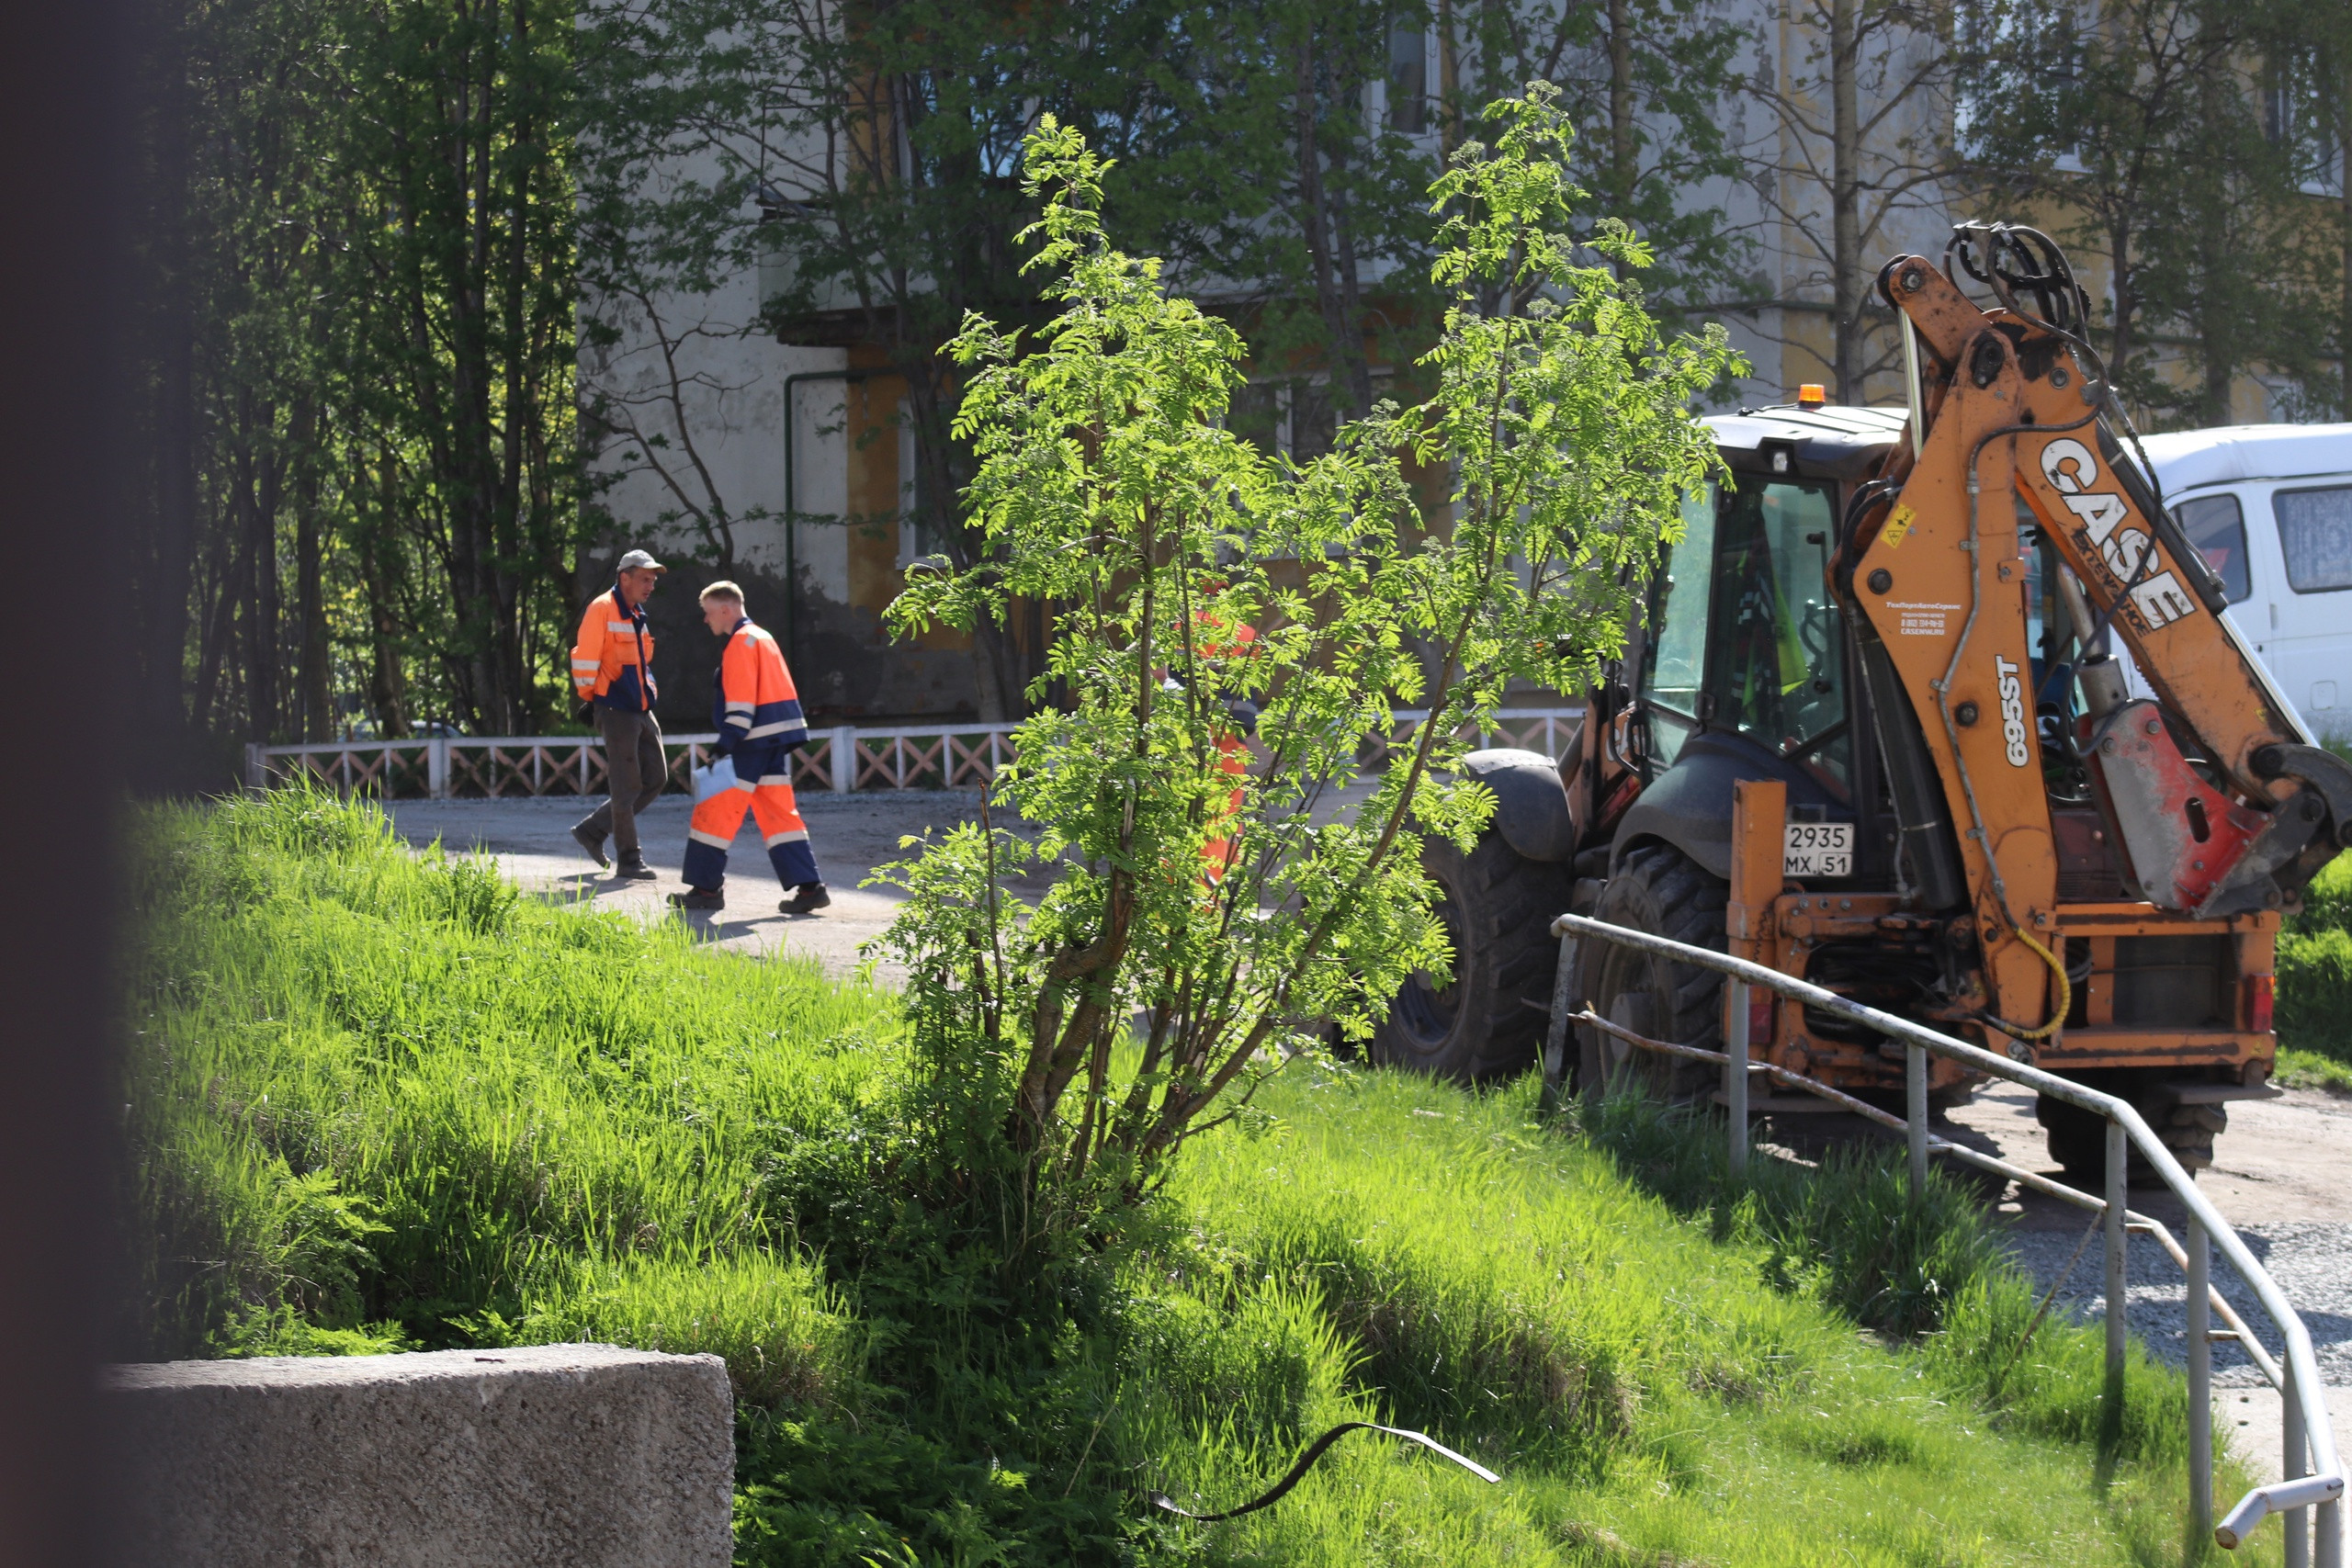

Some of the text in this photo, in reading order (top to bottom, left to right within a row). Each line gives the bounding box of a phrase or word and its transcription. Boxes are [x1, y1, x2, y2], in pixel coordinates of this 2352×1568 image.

[2040, 437, 2197, 631] CASE
[1995, 654, 2029, 768] 695ST
[1790, 828, 1845, 848] 2935
[1825, 856, 1846, 873] 51
